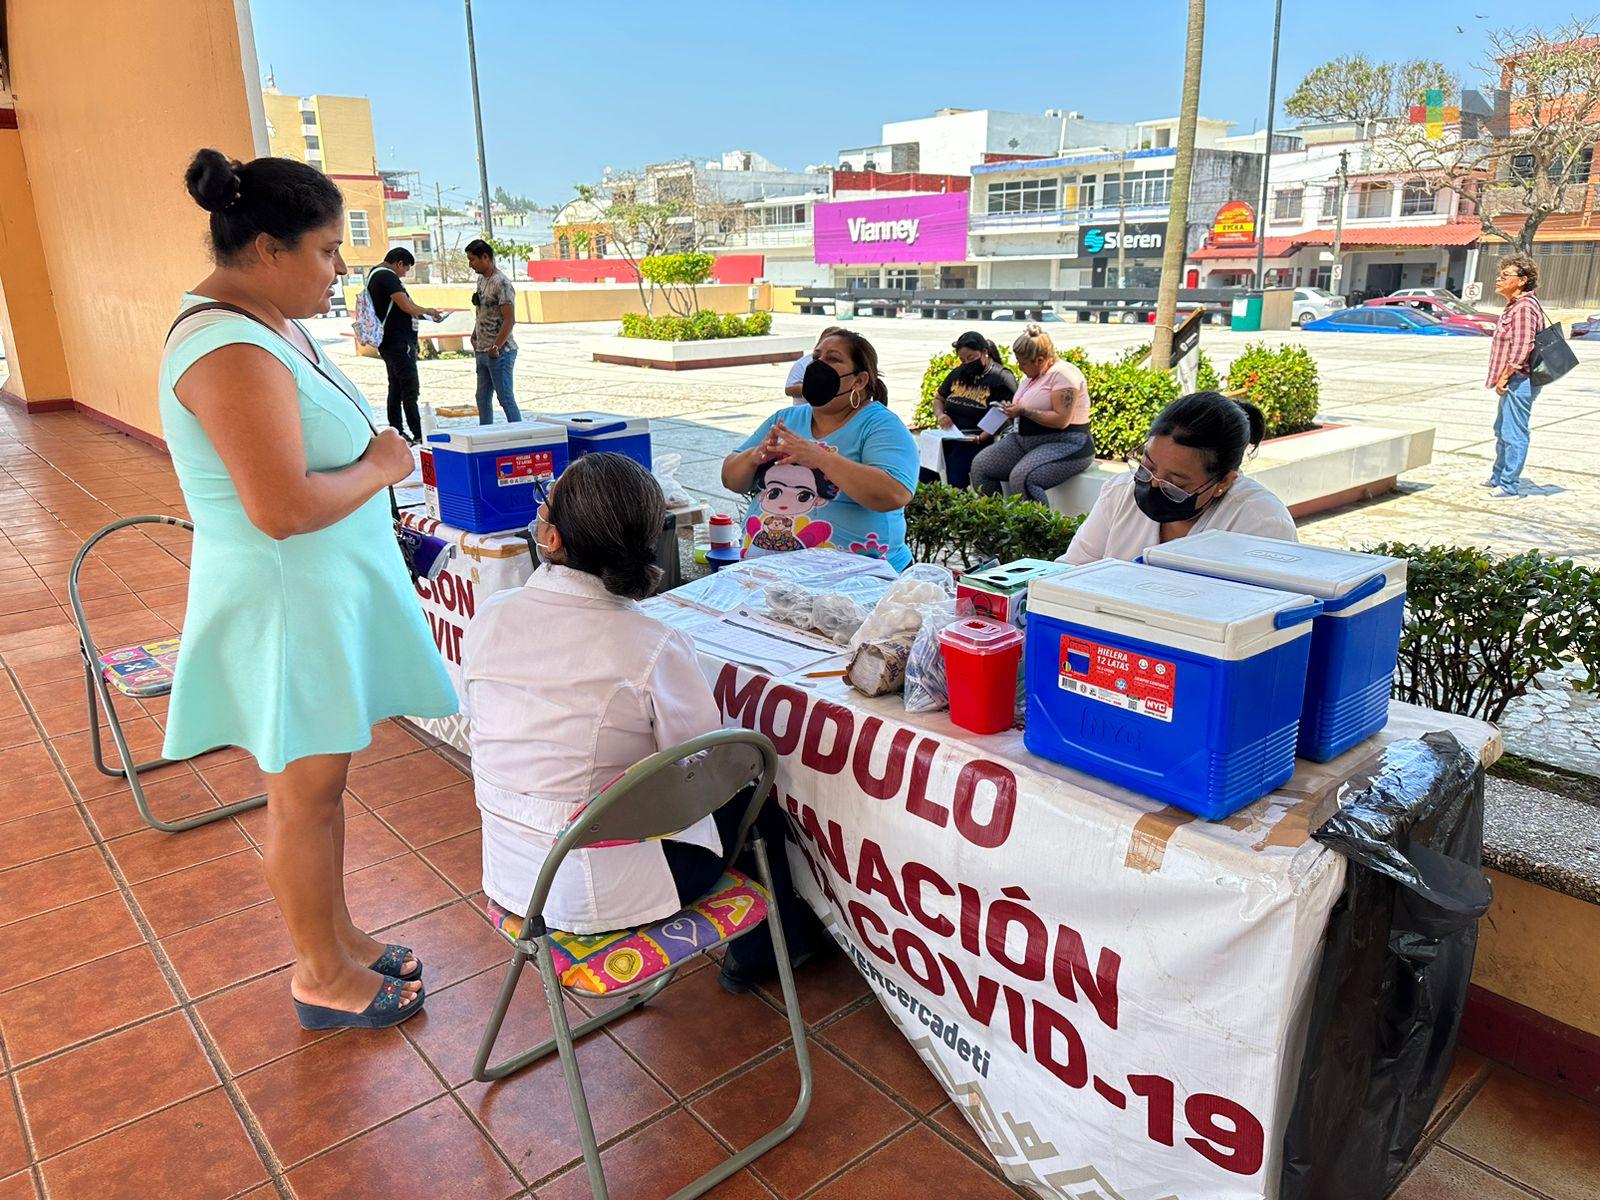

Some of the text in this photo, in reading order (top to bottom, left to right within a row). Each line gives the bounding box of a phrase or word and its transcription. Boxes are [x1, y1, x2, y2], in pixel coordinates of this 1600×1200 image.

[847, 217, 920, 245] Vianney
[1097, 646, 1128, 662] HIELERA
[1097, 656, 1107, 665] 12
[1107, 659, 1130, 672] LATAS
[1146, 700, 1166, 712] NYC
[713, 662, 1018, 849] MODULO
[787, 793, 1121, 1030] NACIÓN
